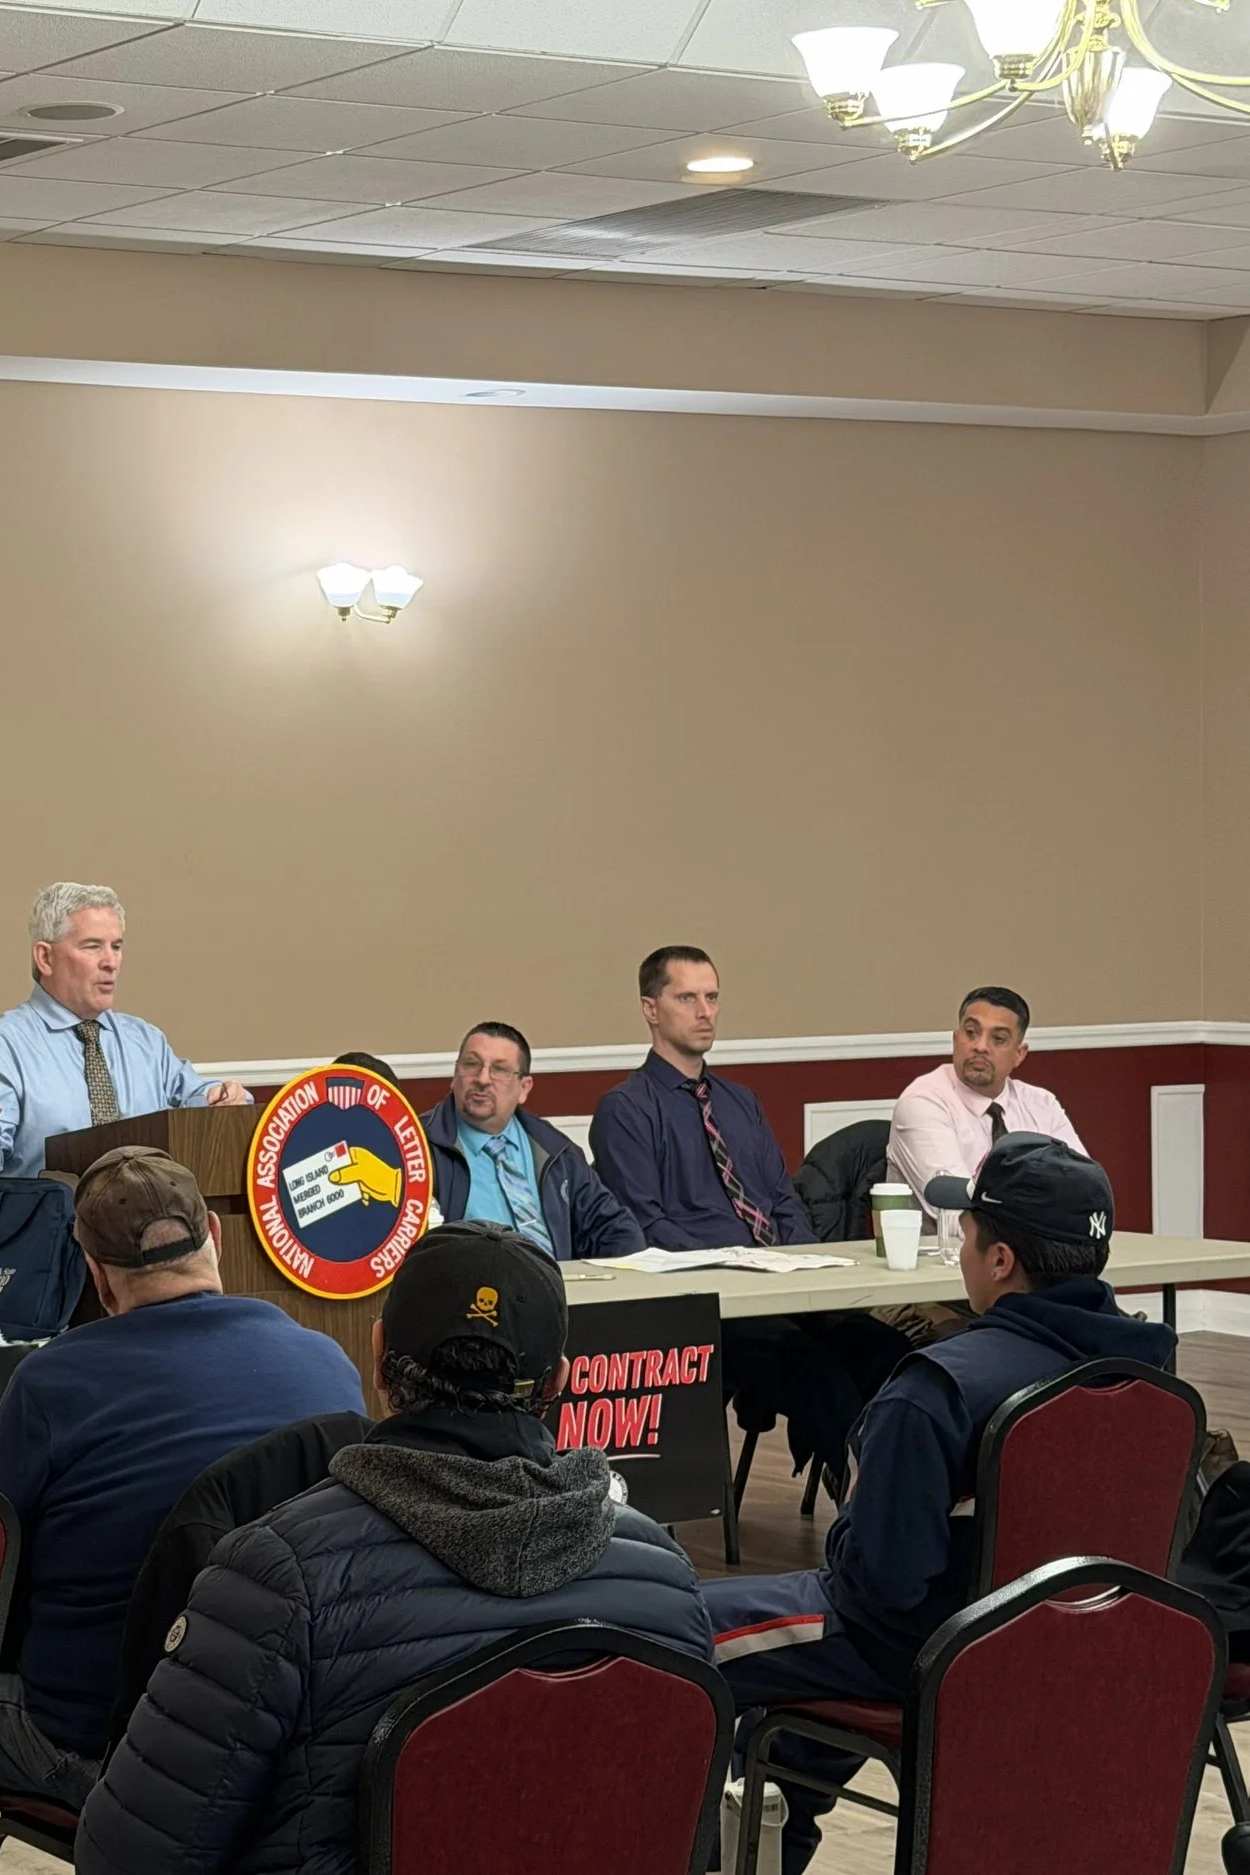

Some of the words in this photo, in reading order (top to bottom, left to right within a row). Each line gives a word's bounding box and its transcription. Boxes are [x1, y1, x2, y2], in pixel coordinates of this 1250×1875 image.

[366, 1084, 391, 1111] OF
[256, 1080, 319, 1189] ASSOCIATION
[393, 1115, 426, 1183] LETTER
[289, 1176, 305, 1192] LONG
[305, 1164, 329, 1183] ISLAND
[292, 1184, 321, 1205] MERGED
[297, 1197, 326, 1219] BRANCH
[326, 1188, 345, 1205] 6000
[259, 1194, 315, 1279] NATIONAL
[370, 1198, 424, 1278] CARRIERS
[1088, 1210, 1107, 1240] NY
[570, 1344, 714, 1395] CONTRACT
[556, 1393, 662, 1451] NOW!
